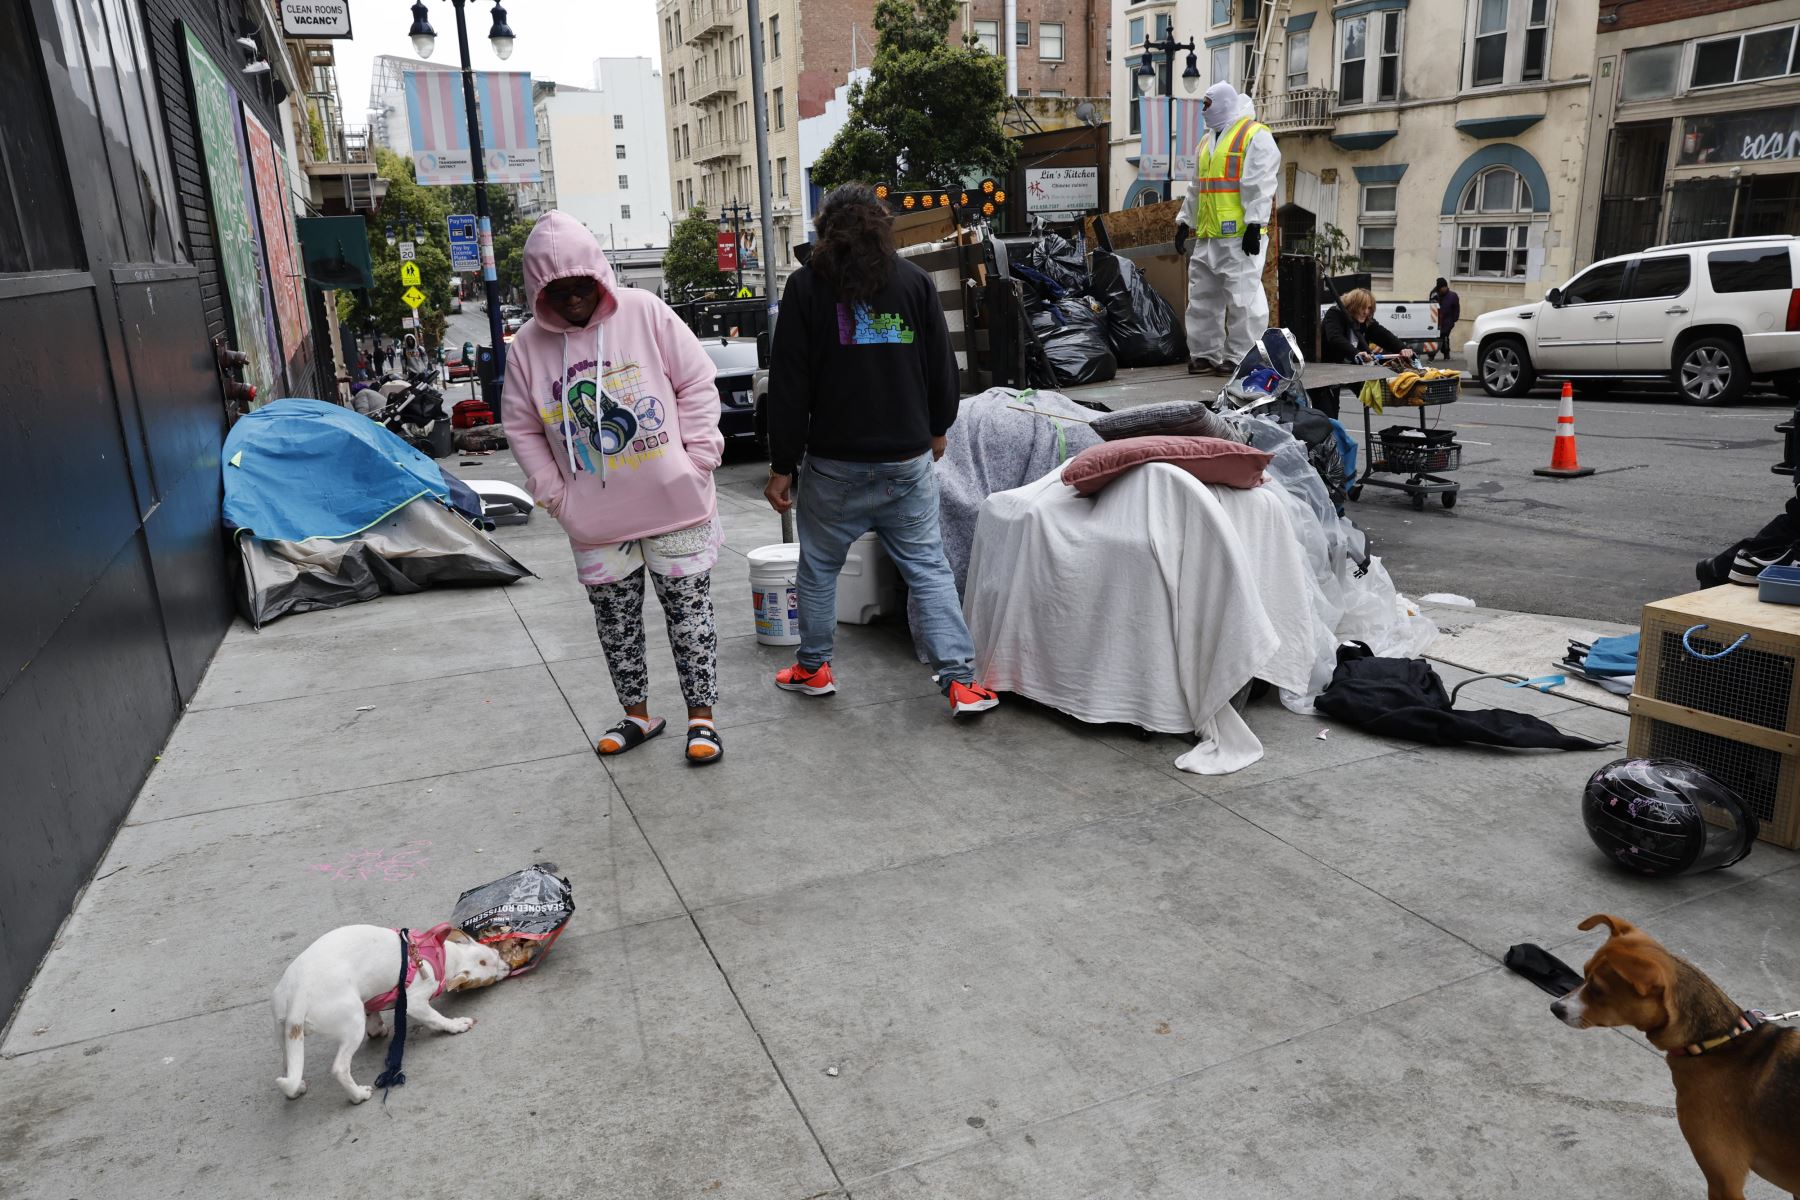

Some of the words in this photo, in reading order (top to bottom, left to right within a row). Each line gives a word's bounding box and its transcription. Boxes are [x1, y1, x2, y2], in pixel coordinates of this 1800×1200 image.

[286, 4, 312, 14] CLEAN
[314, 5, 343, 15] ROOMS
[294, 16, 338, 25] VACANCY
[1040, 169, 1061, 180] Lin's
[1063, 168, 1096, 179] Kitchen
[402, 251, 414, 259] 20
[516, 902, 565, 912] SEASONED
[464, 903, 515, 926] ROTISSERIE
